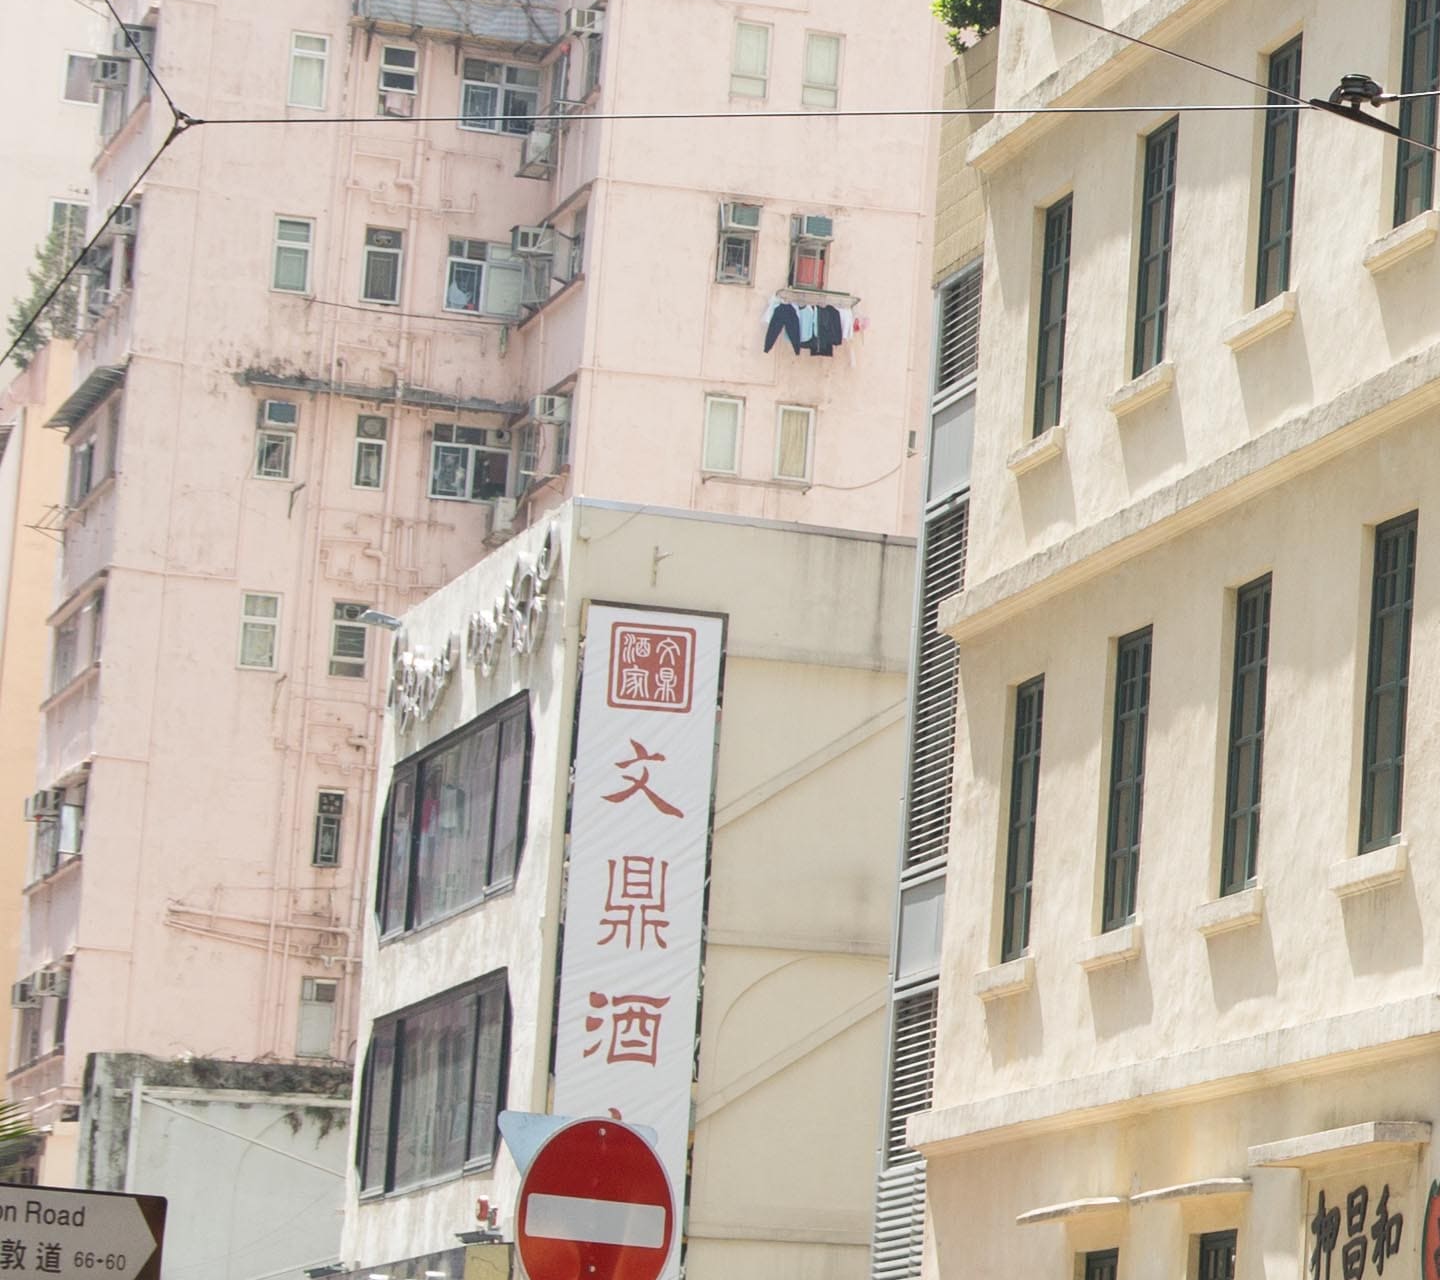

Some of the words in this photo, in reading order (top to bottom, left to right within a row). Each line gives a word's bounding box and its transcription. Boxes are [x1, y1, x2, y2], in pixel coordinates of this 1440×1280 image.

[583, 739, 684, 1118] 文鼎酒
[25, 1200, 86, 1227] Road
[0, 1238, 62, 1273] 敦道
